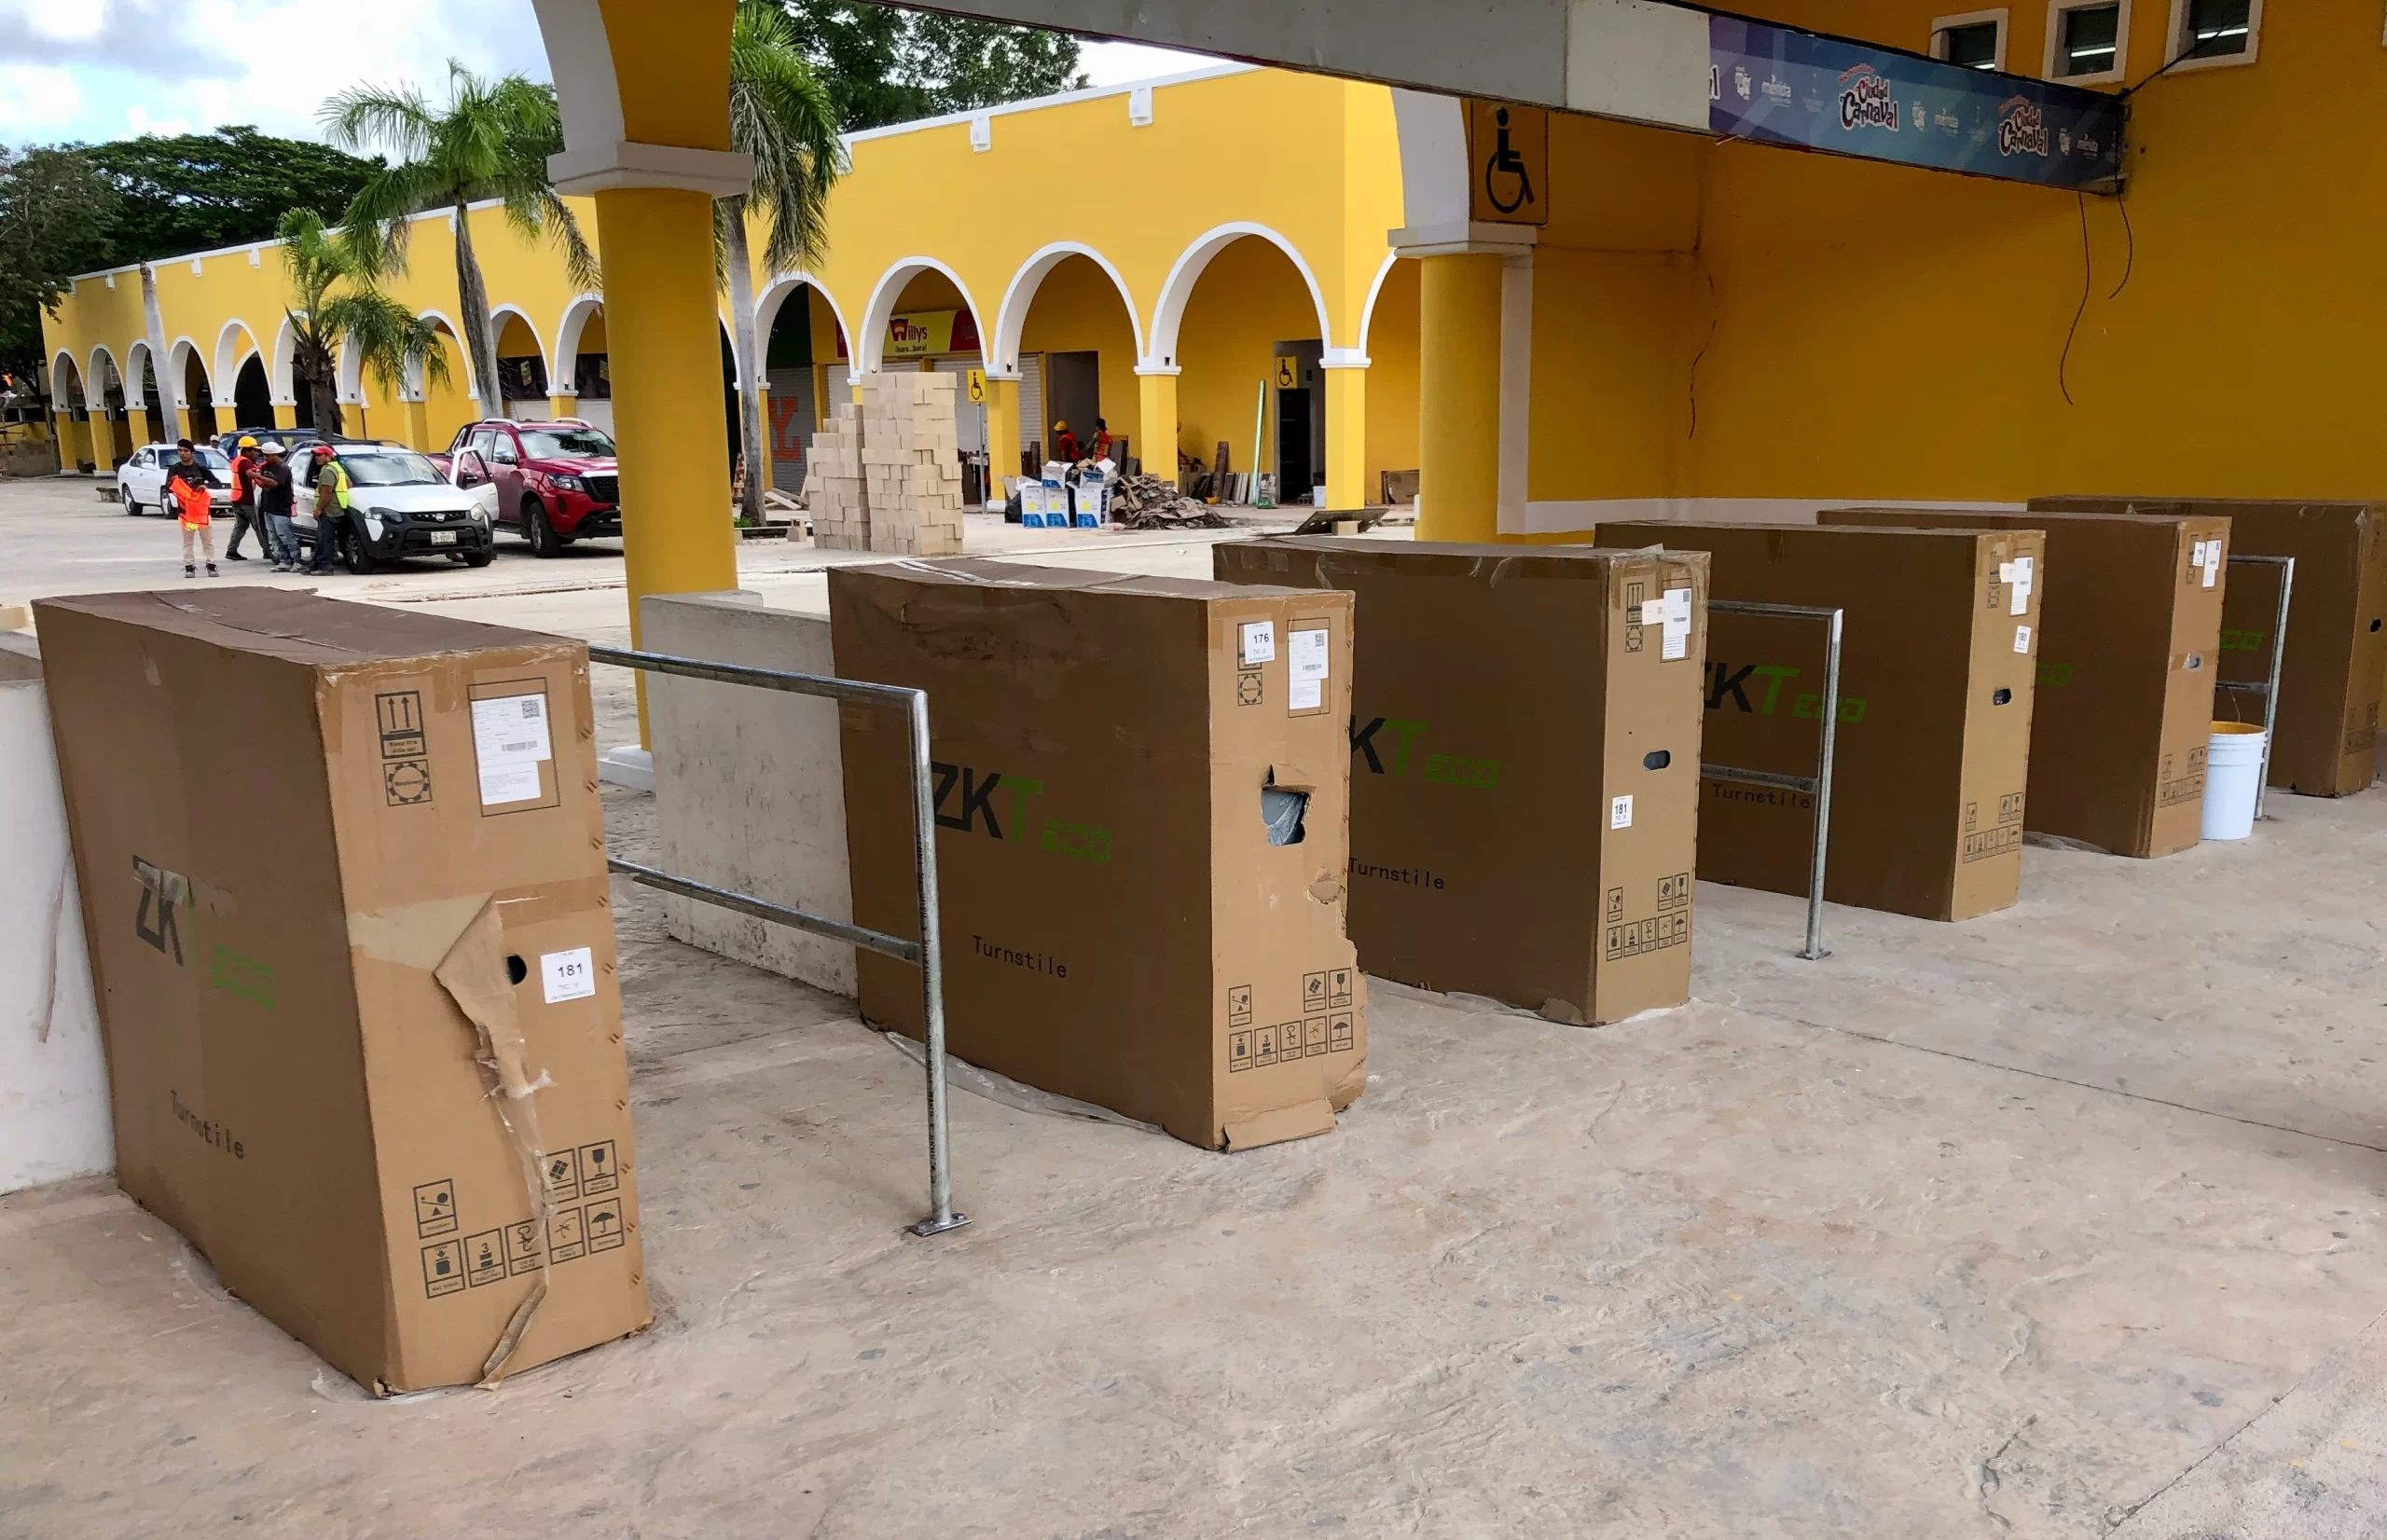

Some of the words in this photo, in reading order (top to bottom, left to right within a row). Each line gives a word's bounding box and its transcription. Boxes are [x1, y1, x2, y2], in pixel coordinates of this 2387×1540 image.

[1856, 78, 1888, 103] Ciudad
[889, 318, 928, 343] Willys
[1253, 633, 1270, 644] 176
[1713, 783, 1811, 809] Turnstile
[1615, 803, 1627, 815] 181
[1349, 857, 1444, 889] Turnstile
[973, 934, 1068, 979] Turnstile
[558, 962, 583, 978] 181
